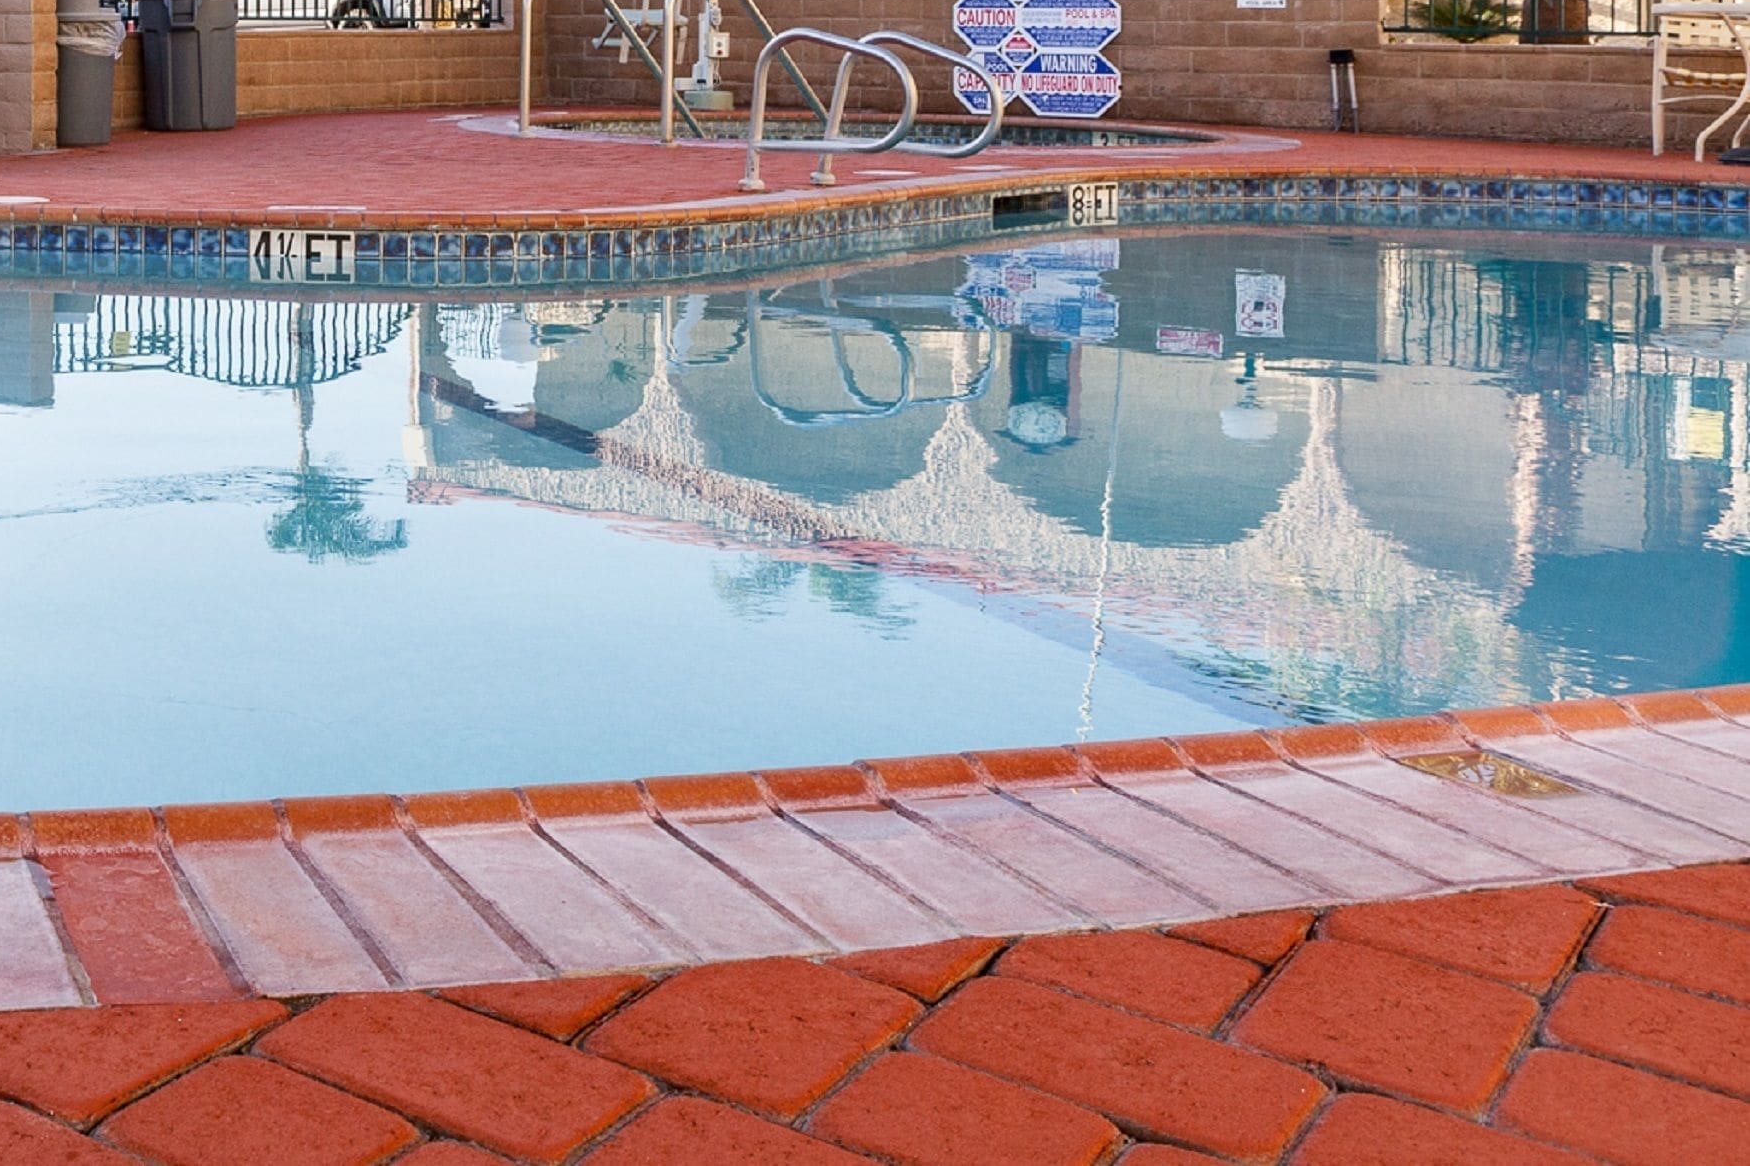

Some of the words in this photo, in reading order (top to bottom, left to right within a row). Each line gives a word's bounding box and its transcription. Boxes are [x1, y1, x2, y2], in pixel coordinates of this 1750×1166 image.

[956, 8, 1016, 26] CAUTION
[1065, 9, 1090, 19] POOL
[1092, 9, 1098, 19] &
[1100, 8, 1117, 19] SPA
[1040, 55, 1097, 73] WARNING
[1021, 74, 1032, 92] NO
[1035, 74, 1078, 92] LIFEGUARD
[1081, 75, 1093, 92] ON
[1095, 76, 1118, 93] DUTY
